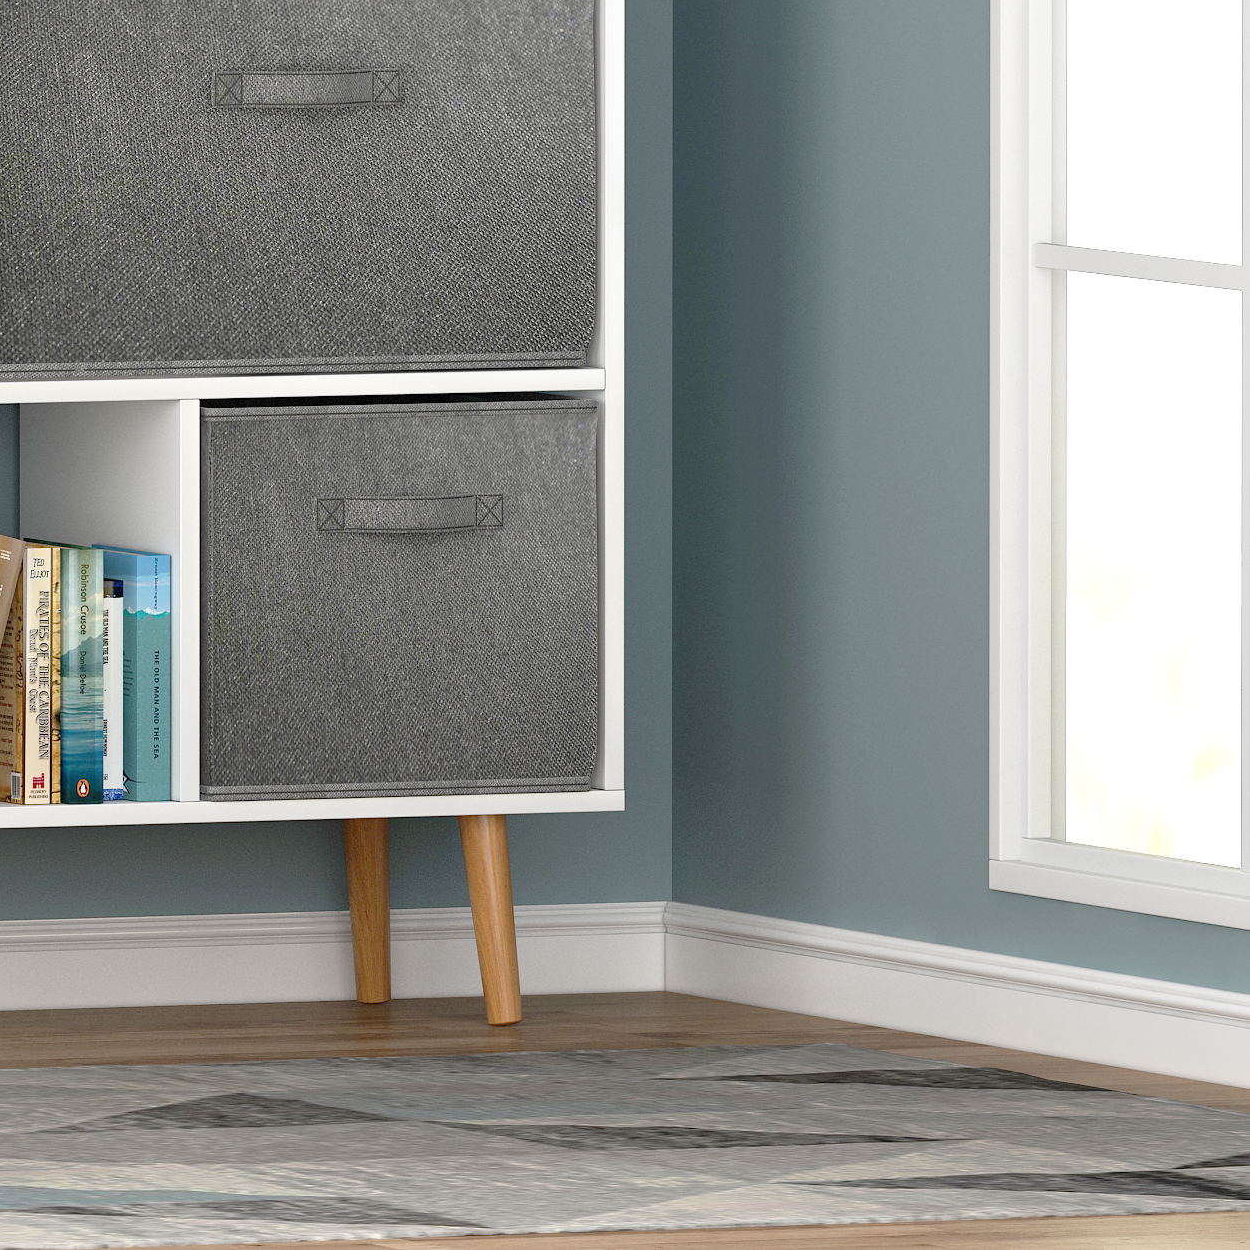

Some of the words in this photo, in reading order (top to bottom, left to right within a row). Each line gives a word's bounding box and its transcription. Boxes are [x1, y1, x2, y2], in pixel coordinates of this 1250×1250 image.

[33, 558, 45, 567] TED
[80, 564, 89, 603] Robinson
[36, 590, 49, 641] PIRATES
[80, 605, 89, 635] Crusoe
[37, 642, 49, 662] OF
[79, 651, 87, 670] Daniel
[39, 663, 49, 689] THE
[79, 674, 87, 695] Defoe
[36, 690, 49, 760] CARIBBEAN
